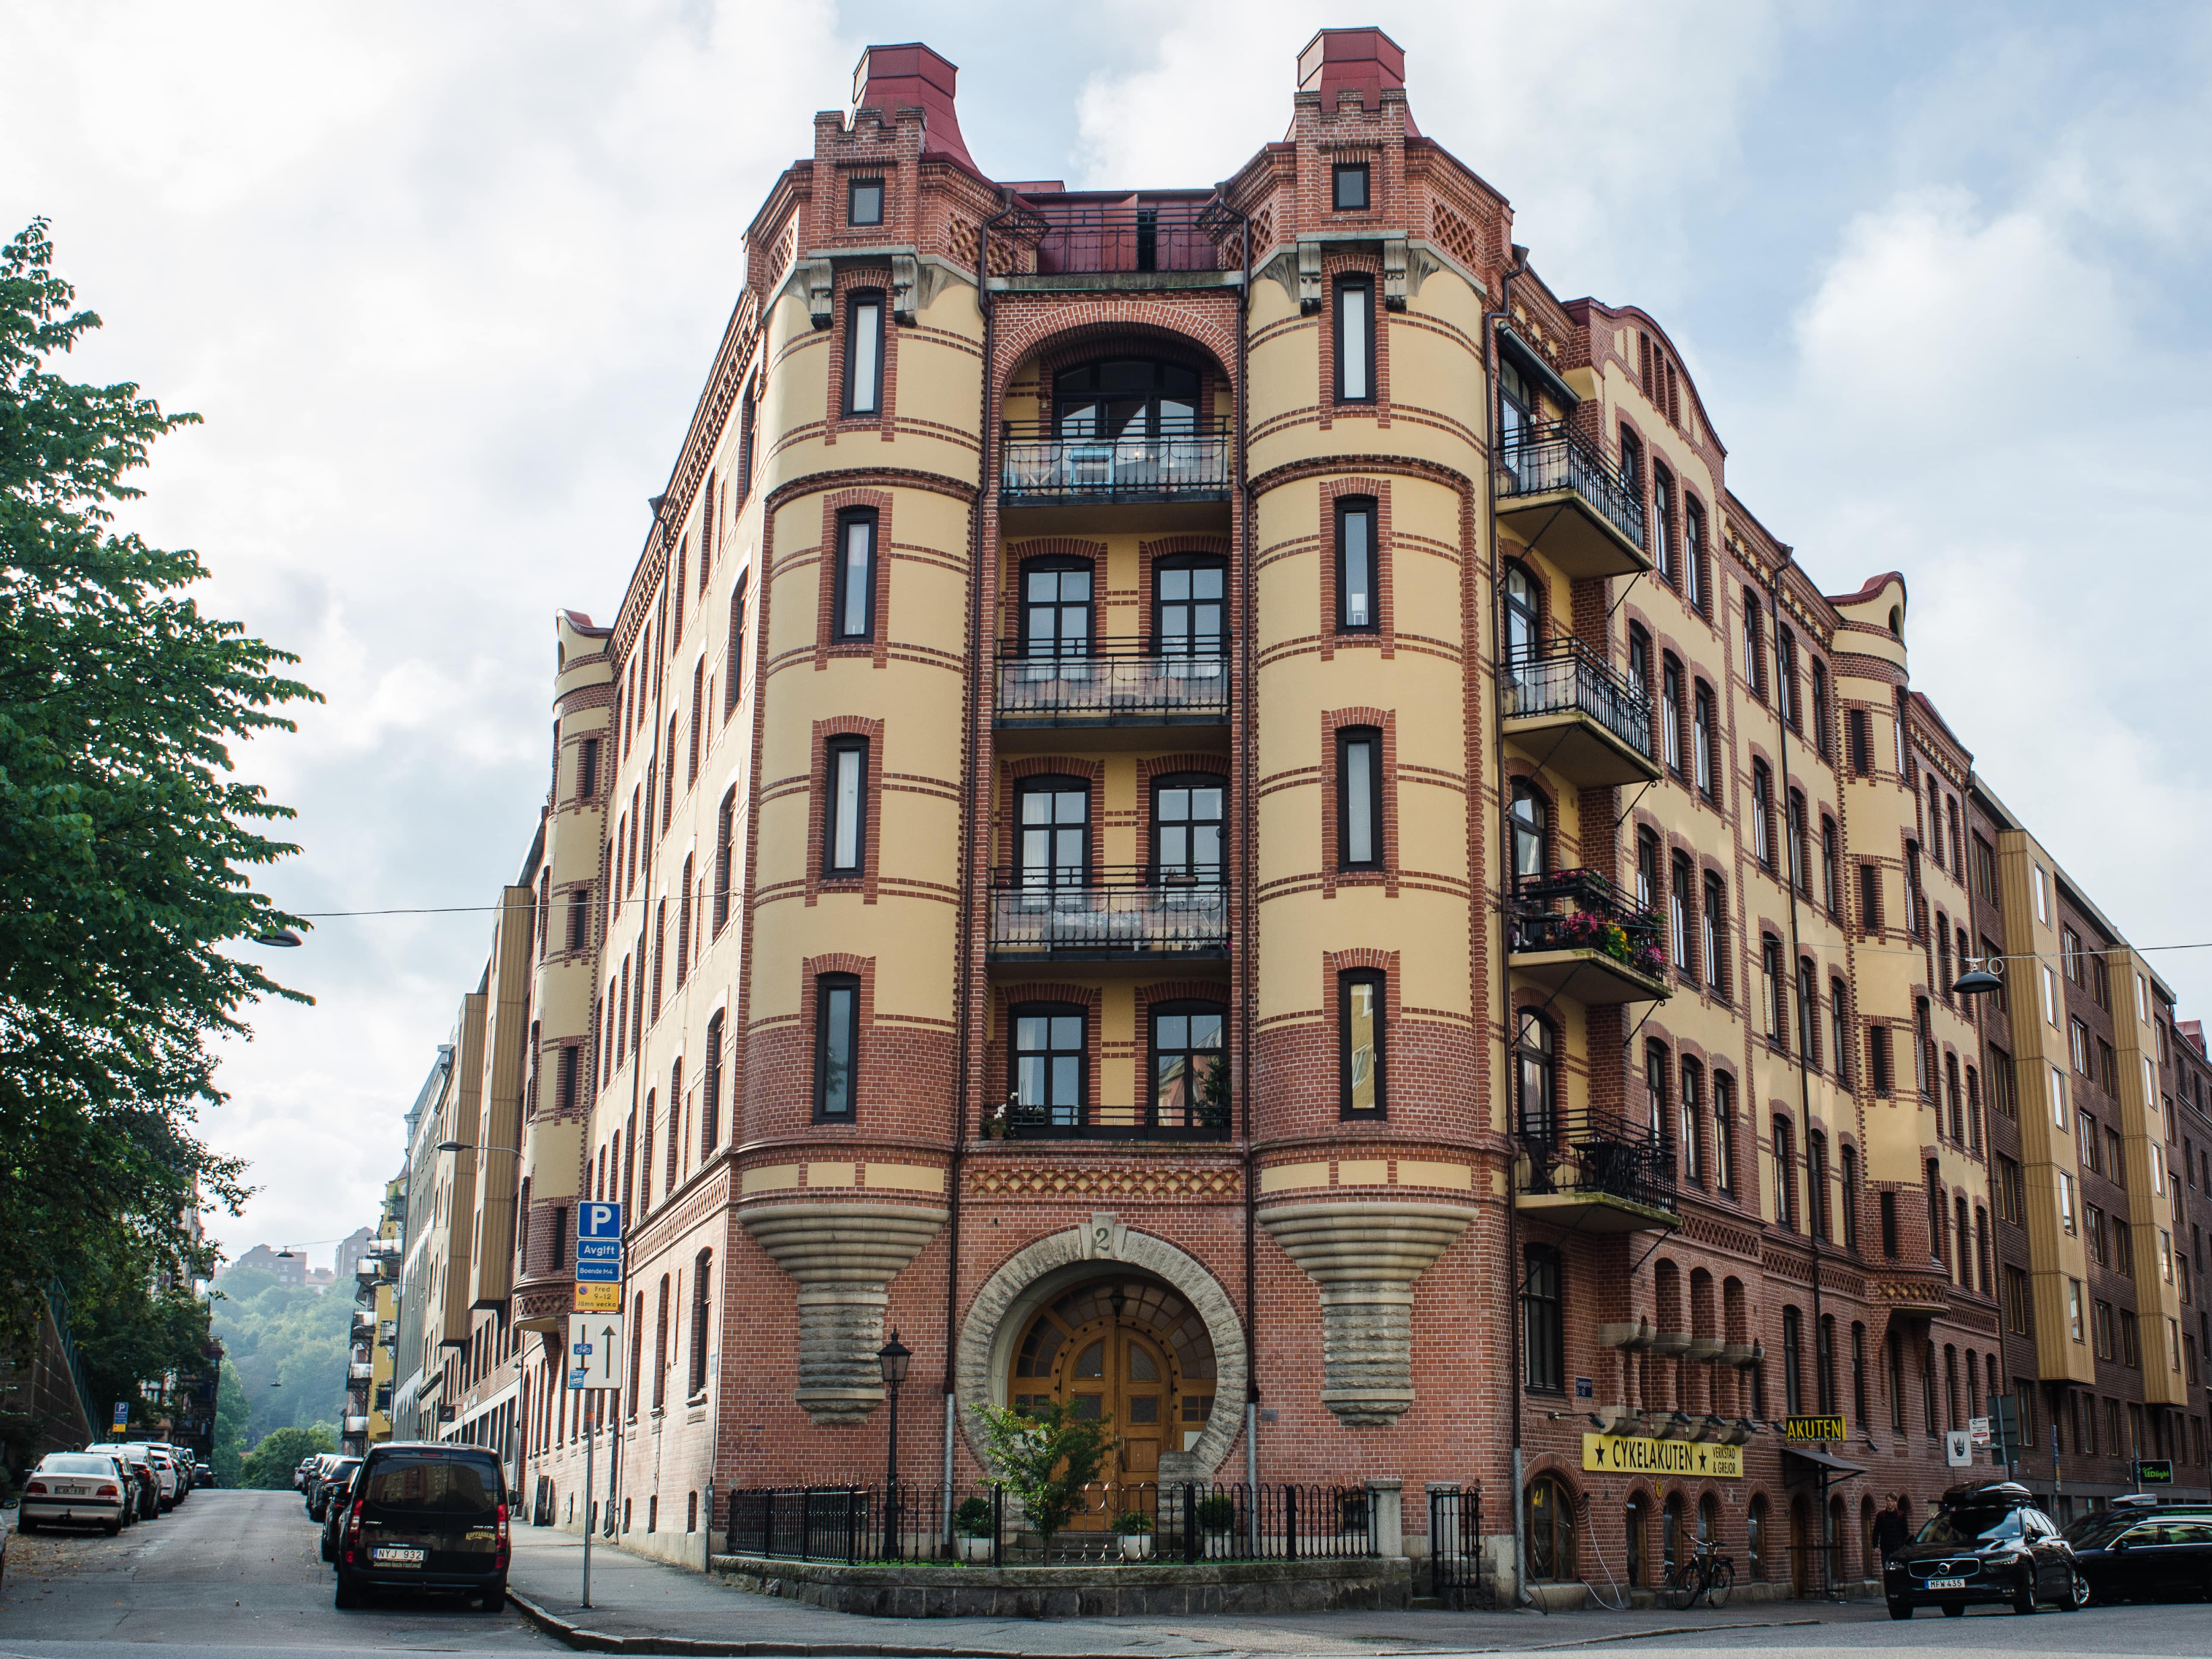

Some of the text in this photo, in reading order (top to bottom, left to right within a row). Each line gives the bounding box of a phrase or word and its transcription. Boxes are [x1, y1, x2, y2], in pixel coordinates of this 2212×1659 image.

[591, 1206, 611, 1234] P
[1096, 1227, 1109, 1251] 2
[584, 1245, 615, 1256] Avgift
[119, 1404, 125, 1412] P
[1787, 1420, 1840, 1438] AKUTEN
[1613, 1440, 1693, 1471] CYKELAKUTEN
[1712, 1446, 1735, 1459] VERKSTAD
[1713, 1462, 1736, 1474] & GREJOR
[379, 1549, 422, 1559] NYJ 932
